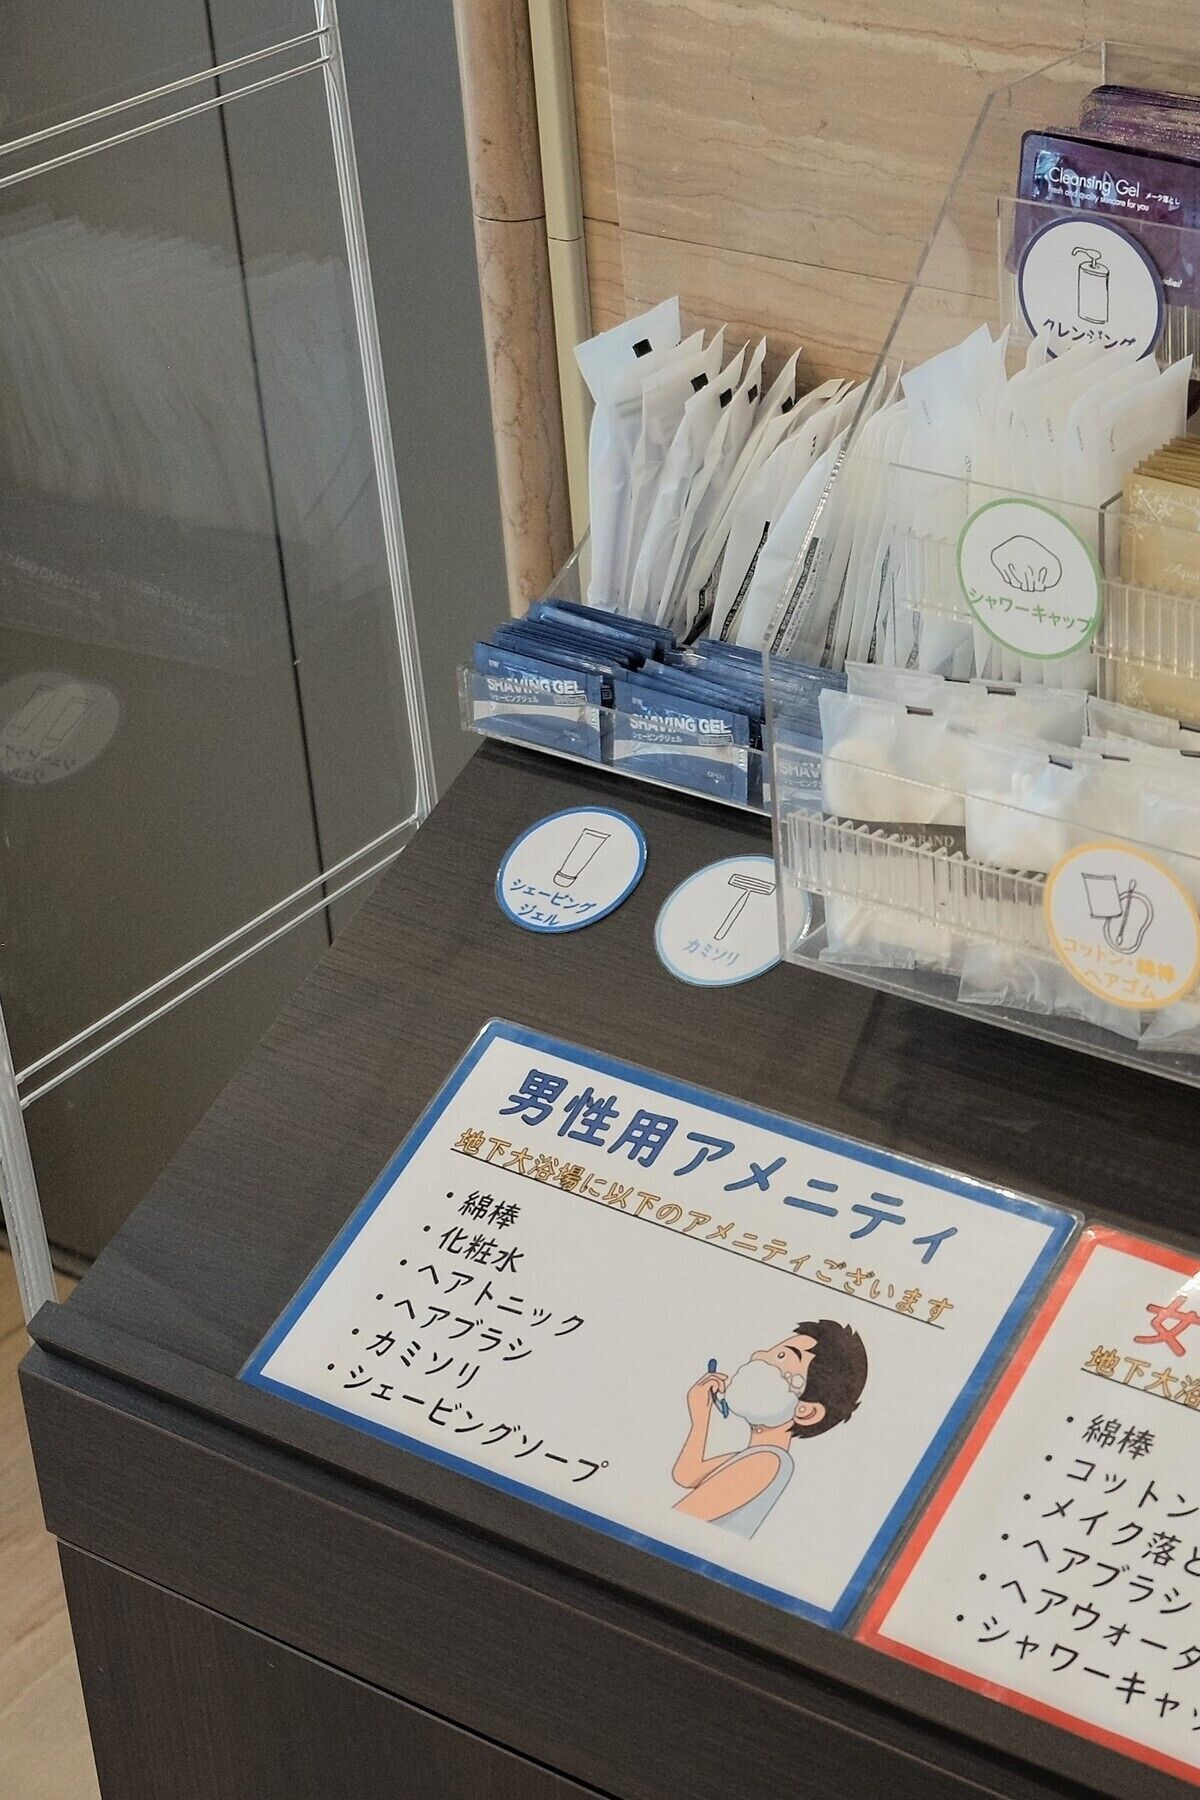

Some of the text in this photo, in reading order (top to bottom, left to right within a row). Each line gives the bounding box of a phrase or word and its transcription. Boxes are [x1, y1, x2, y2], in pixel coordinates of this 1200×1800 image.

[1048, 166, 1140, 198] Cleansing Gel
[1126, 198, 1136, 209] for
[1136, 202, 1149, 211] you
[968, 588, 1094, 633] シャワーキャップ
[486, 676, 586, 695] SHAVING GEL
[629, 713, 732, 735] SHAVING GEL
[781, 762, 822, 778] SHAV
[511, 877, 597, 914] シェービング
[518, 902, 562, 927] ジェル
[682, 937, 741, 966] カミソリ
[499, 1068, 958, 1265] 男性用アメニティ
[453, 1126, 956, 1323] 地下大浴場に以下のアメニティございます
[458, 1189, 522, 1230] 綿棒
[438, 1225, 525, 1273] 化粧水
[418, 1264, 585, 1337] ヘアトニック
[394, 1299, 532, 1361] ヘアブラシ
[365, 1330, 481, 1389] カミソリ
[343, 1364, 610, 1482] シェービングソープ
[1082, 1414, 1155, 1460] 綿棒
[1067, 1458, 1200, 1517] コットン
[1023, 1539, 1193, 1614] ヘアブラシ
